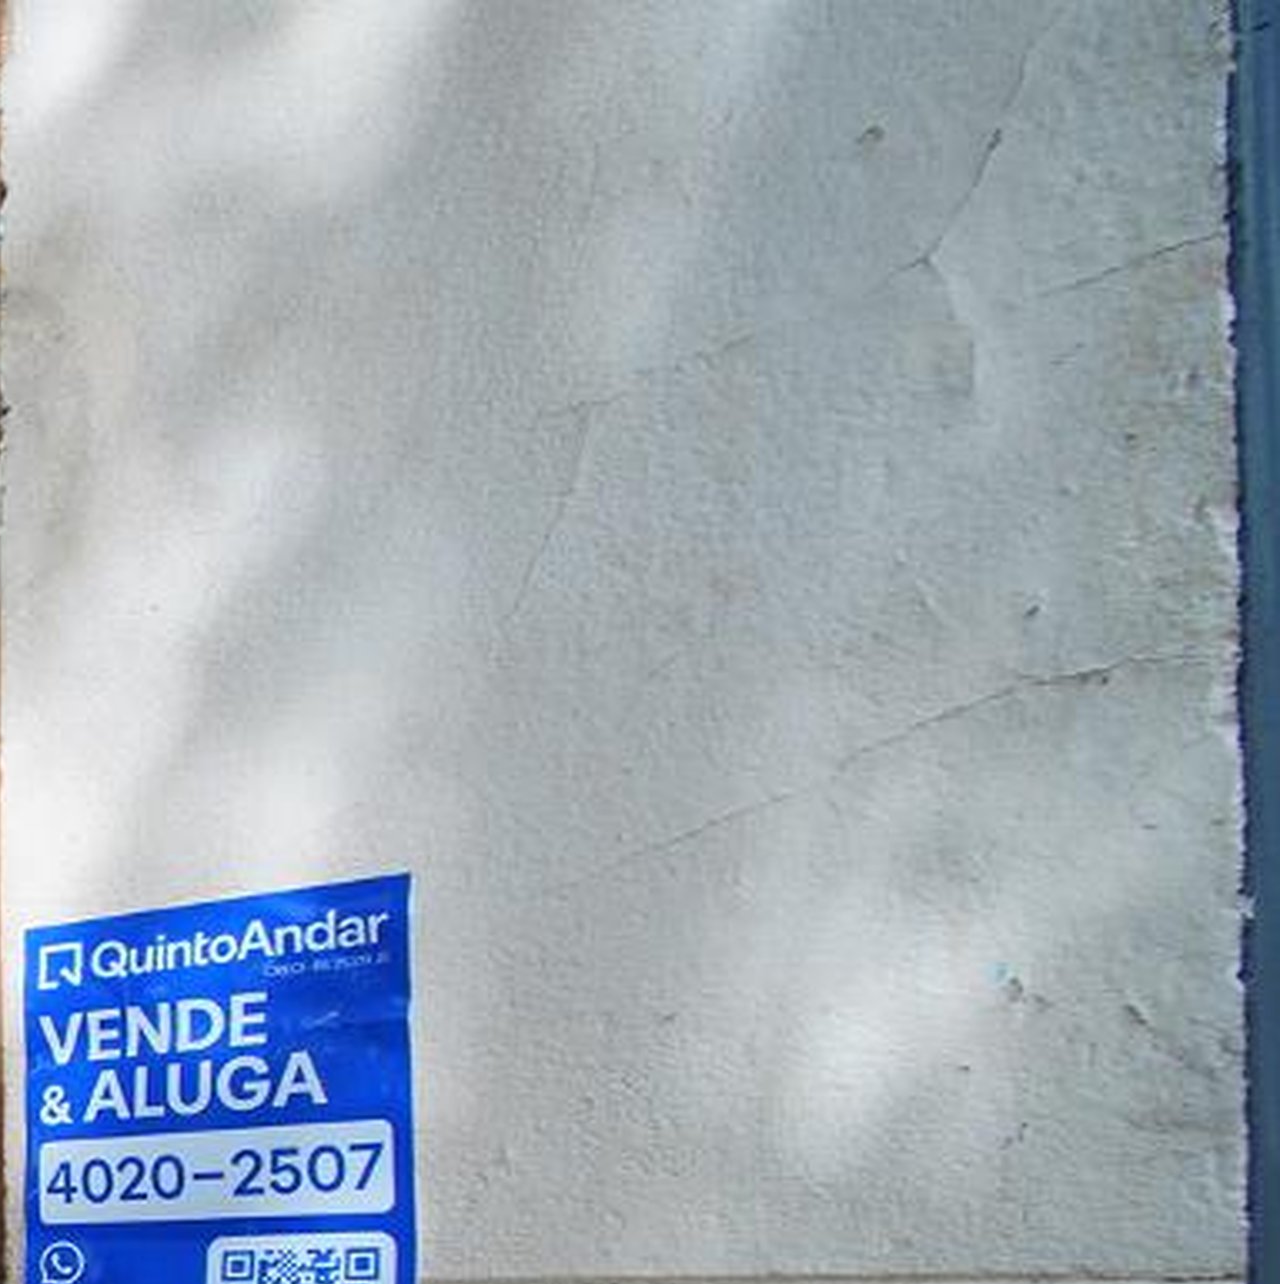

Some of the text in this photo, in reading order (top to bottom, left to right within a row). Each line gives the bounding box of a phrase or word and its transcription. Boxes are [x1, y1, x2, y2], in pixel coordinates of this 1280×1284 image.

[91, 909, 390, 978] QuintoAndar
[38, 991, 268, 1067] VENDE
[39, 1049, 329, 1126] & ALUGA
[45, 1142, 385, 1205] 4020-2507
